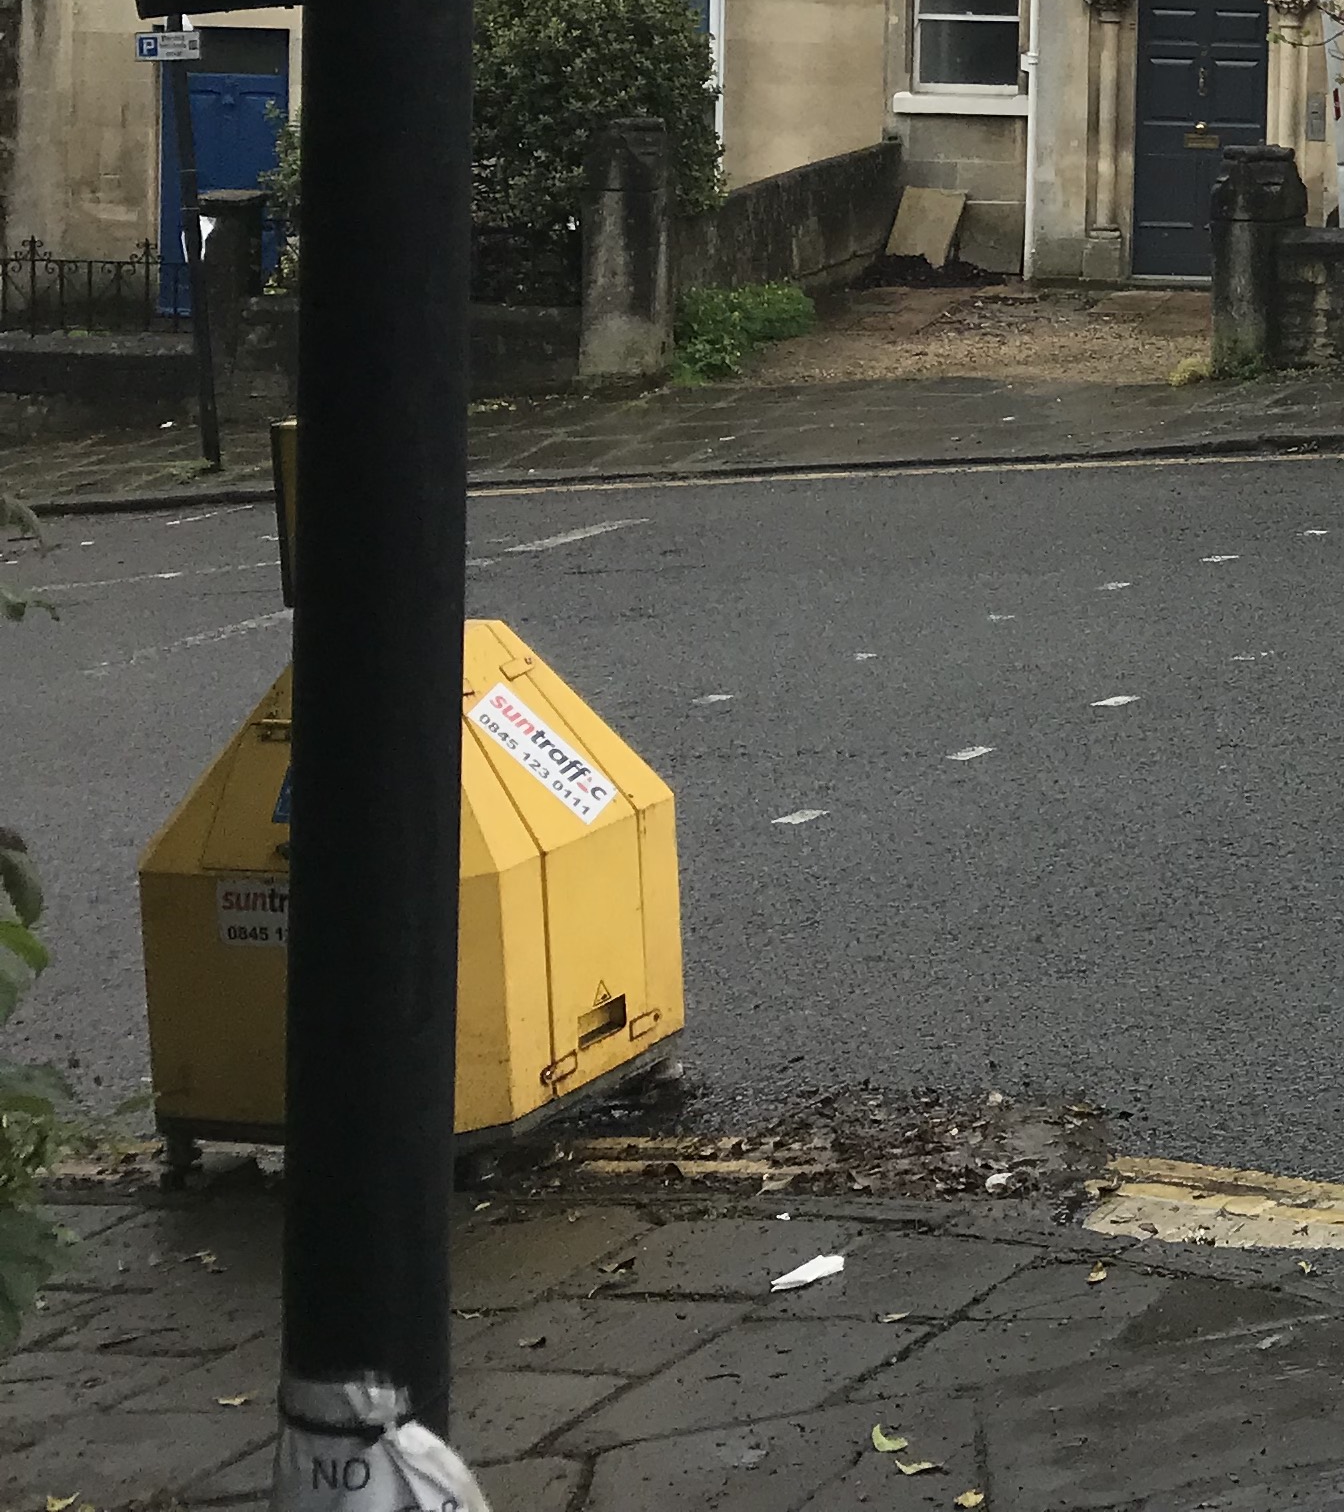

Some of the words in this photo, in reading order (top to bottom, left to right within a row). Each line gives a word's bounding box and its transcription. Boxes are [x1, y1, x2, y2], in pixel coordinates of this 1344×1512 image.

[143, 39, 154, 55] P
[479, 714, 519, 750] 0845
[522, 751, 550, 780] 123
[552, 780, 590, 816] 0111
[227, 926, 269, 941] 0845
[275, 926, 289, 941] 1
[312, 1456, 371, 1491] NO
